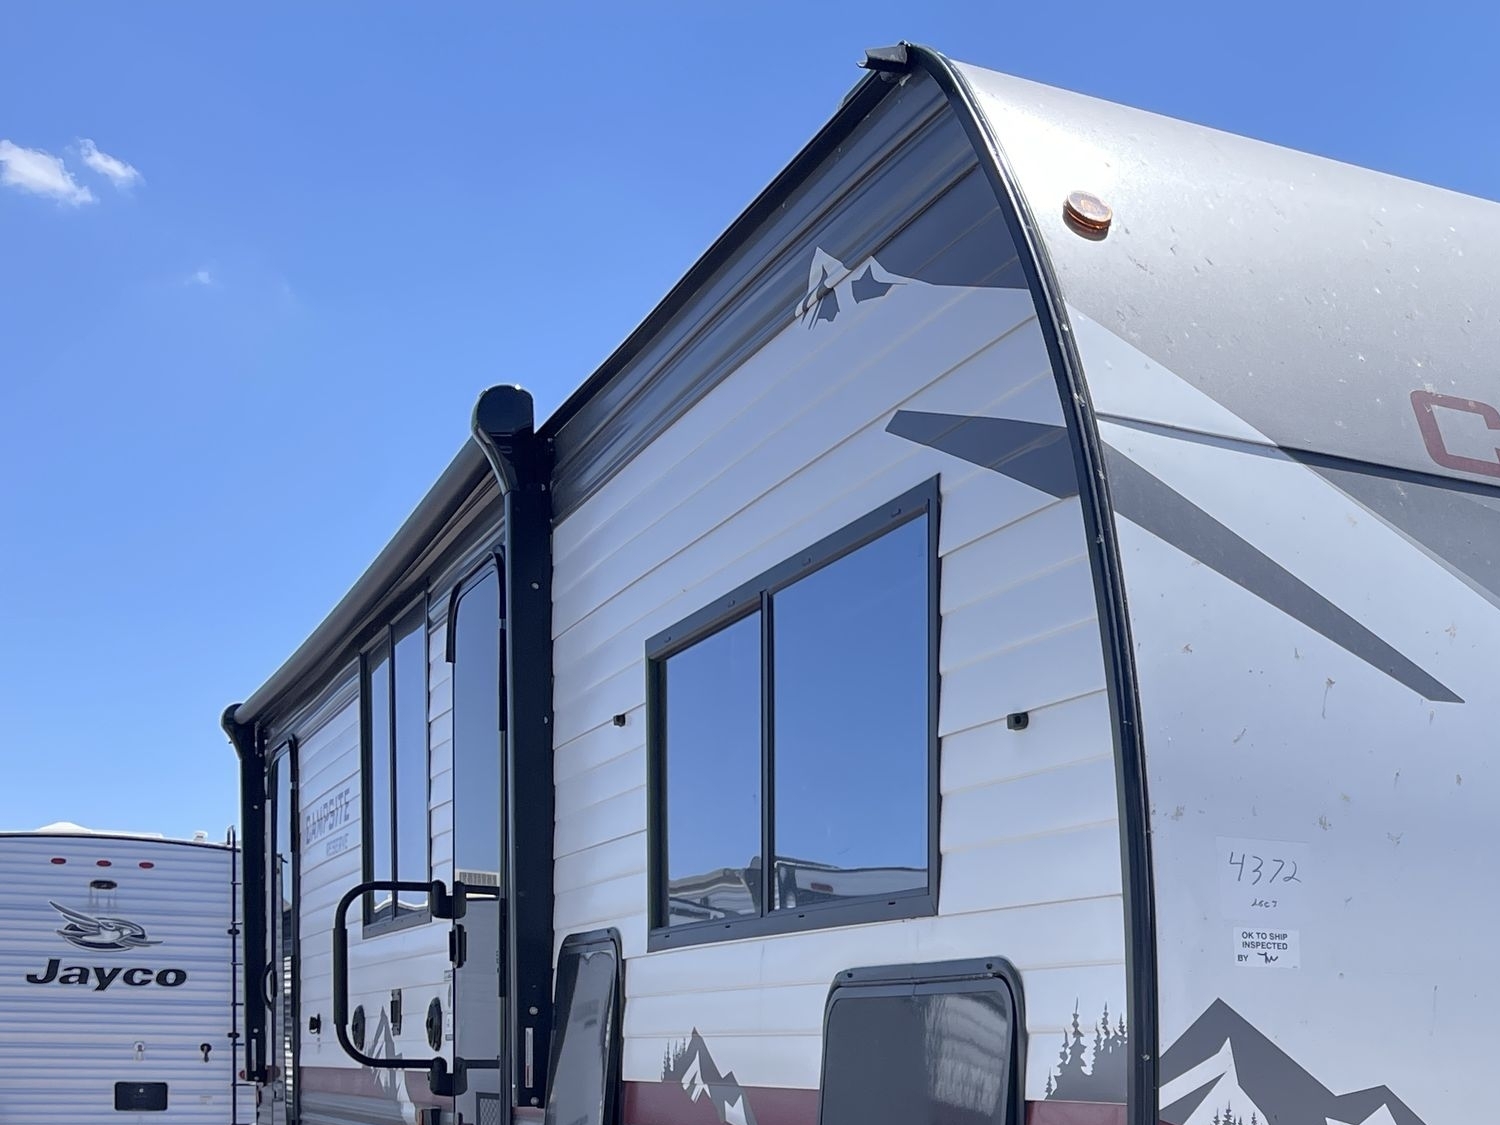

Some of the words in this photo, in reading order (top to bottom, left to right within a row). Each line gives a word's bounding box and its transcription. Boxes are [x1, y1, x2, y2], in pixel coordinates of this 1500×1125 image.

[306, 787, 350, 845] CAMPSITE
[1229, 851, 1302, 885] 4372
[1241, 931, 1254, 940] OK
[1255, 932, 1268, 940] TO
[1269, 933, 1288, 941] SHIP
[1242, 941, 1288, 950] INSPECTED
[1237, 954, 1249, 962] BY
[26, 958, 187, 992] Jayco
